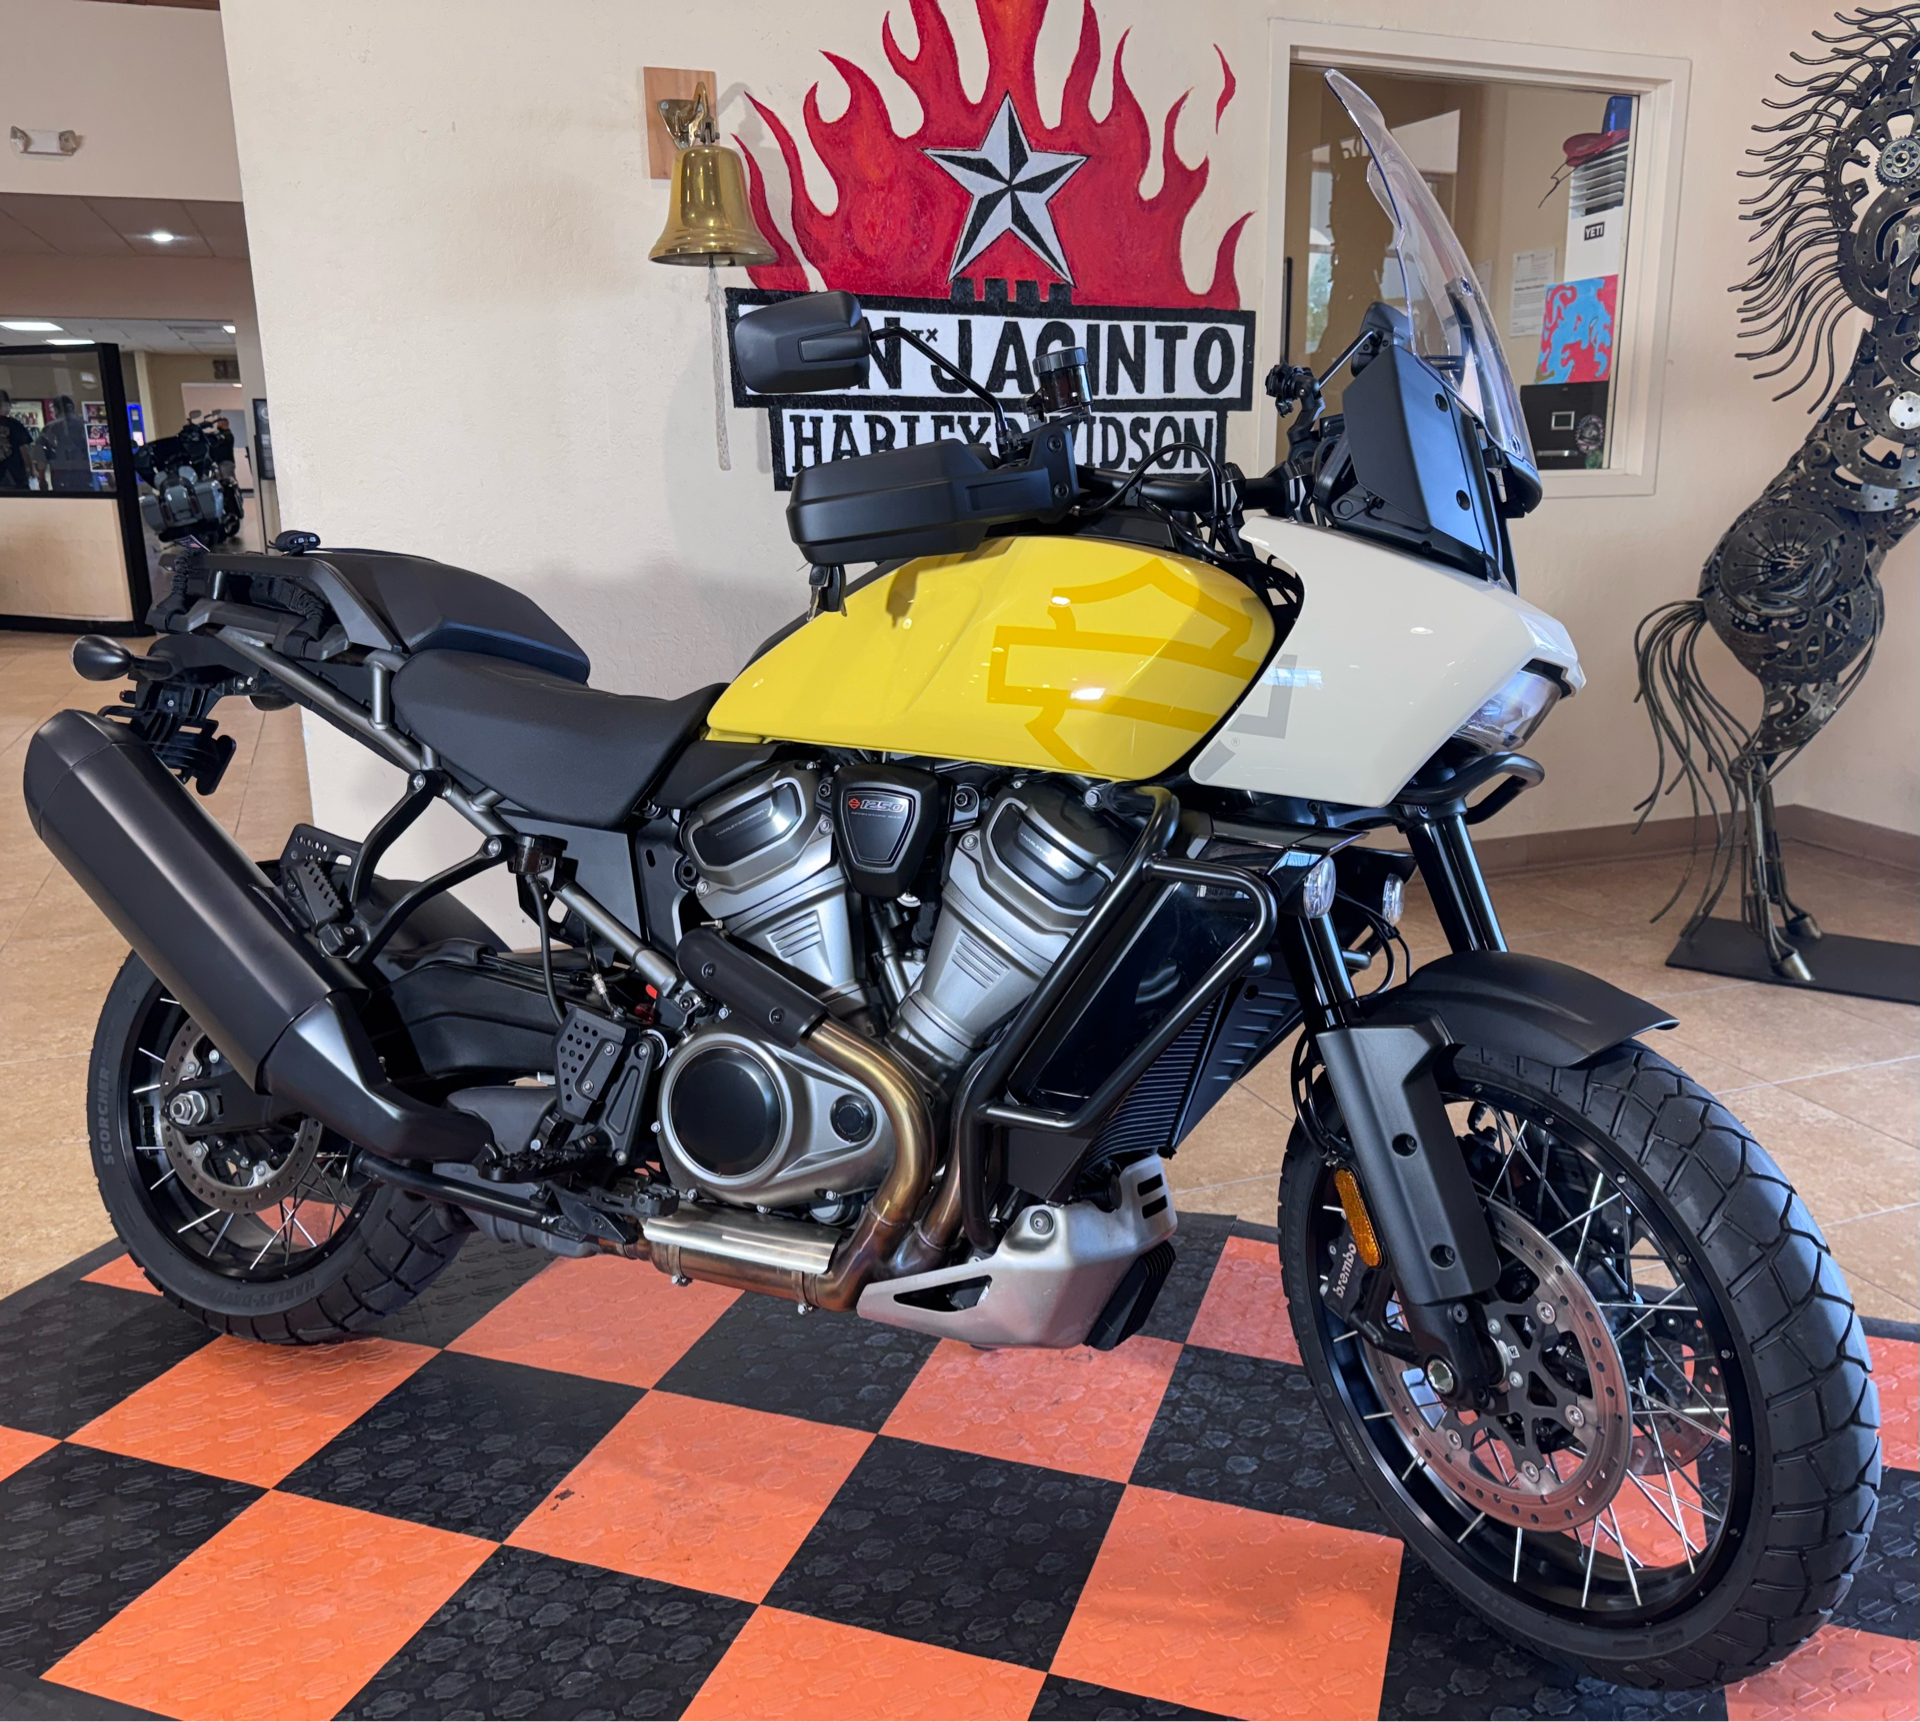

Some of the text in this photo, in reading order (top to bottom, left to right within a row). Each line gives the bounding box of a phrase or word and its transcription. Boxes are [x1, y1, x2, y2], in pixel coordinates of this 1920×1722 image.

[1585, 224, 1604, 239] YETI
[860, 799, 904, 812] 1250
[97, 1066, 116, 1166] SCORCHER
[1332, 1243, 1357, 1299] brembo
